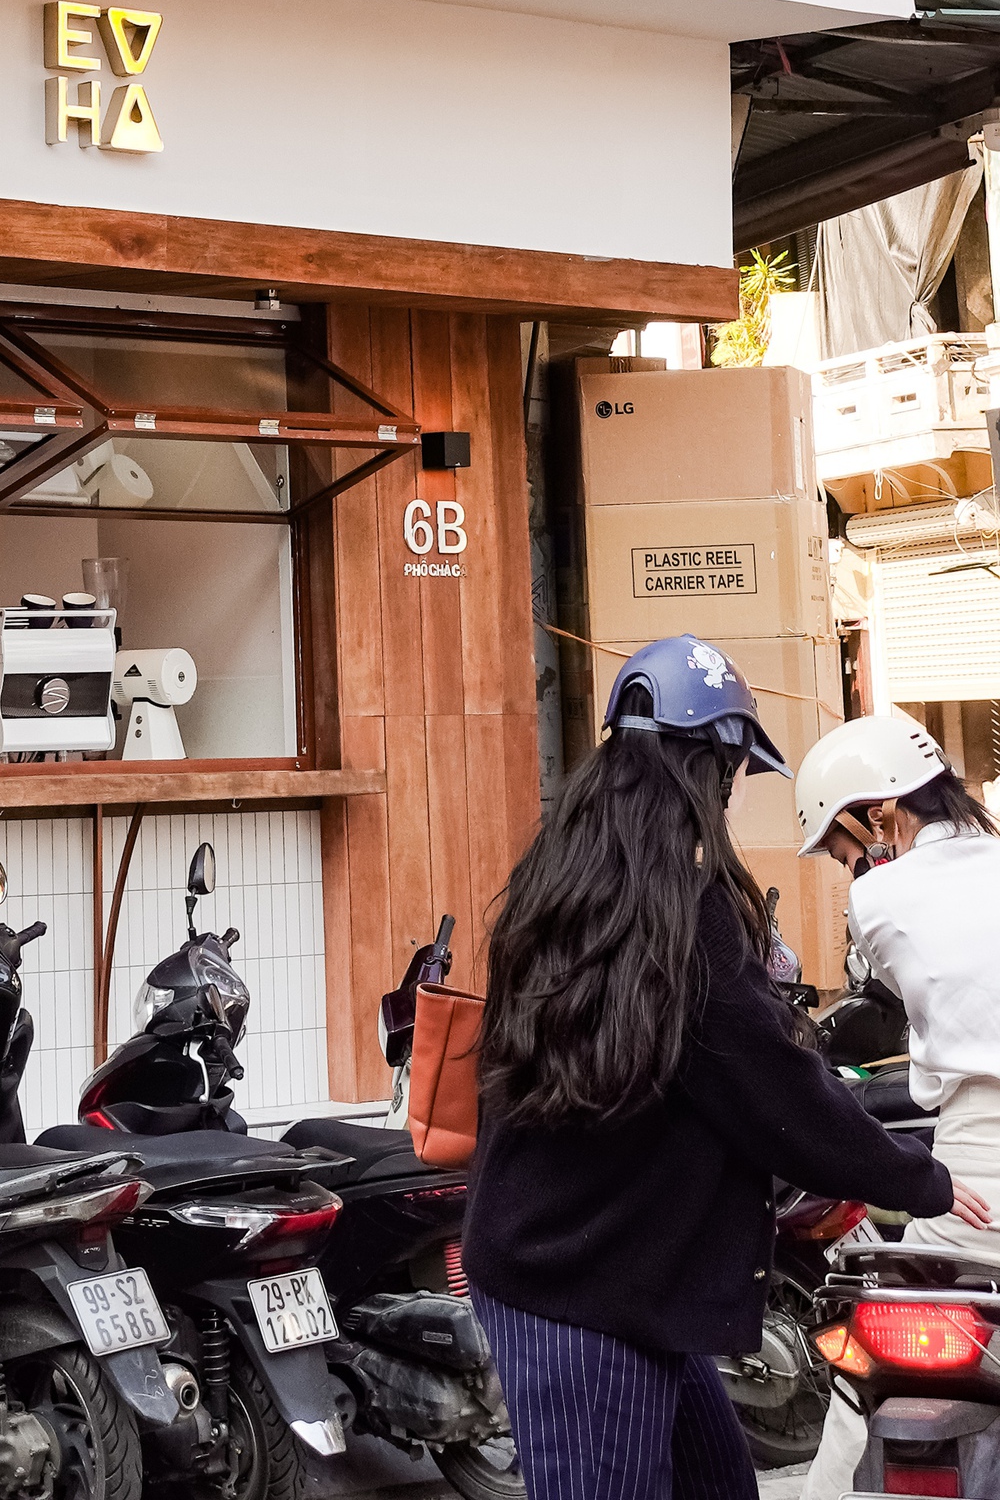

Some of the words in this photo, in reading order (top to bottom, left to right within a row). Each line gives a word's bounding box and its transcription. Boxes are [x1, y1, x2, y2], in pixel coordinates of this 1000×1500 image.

[614, 402, 635, 415] LG
[403, 499, 468, 555] 6B
[644, 552, 702, 569] PLASTIC
[706, 550, 742, 566] REEL
[645, 575, 705, 592] CARRIER
[708, 573, 745, 589] TAPE
[81, 1276, 145, 1315] 99-S2
[95, 1307, 157, 1348] 6586
